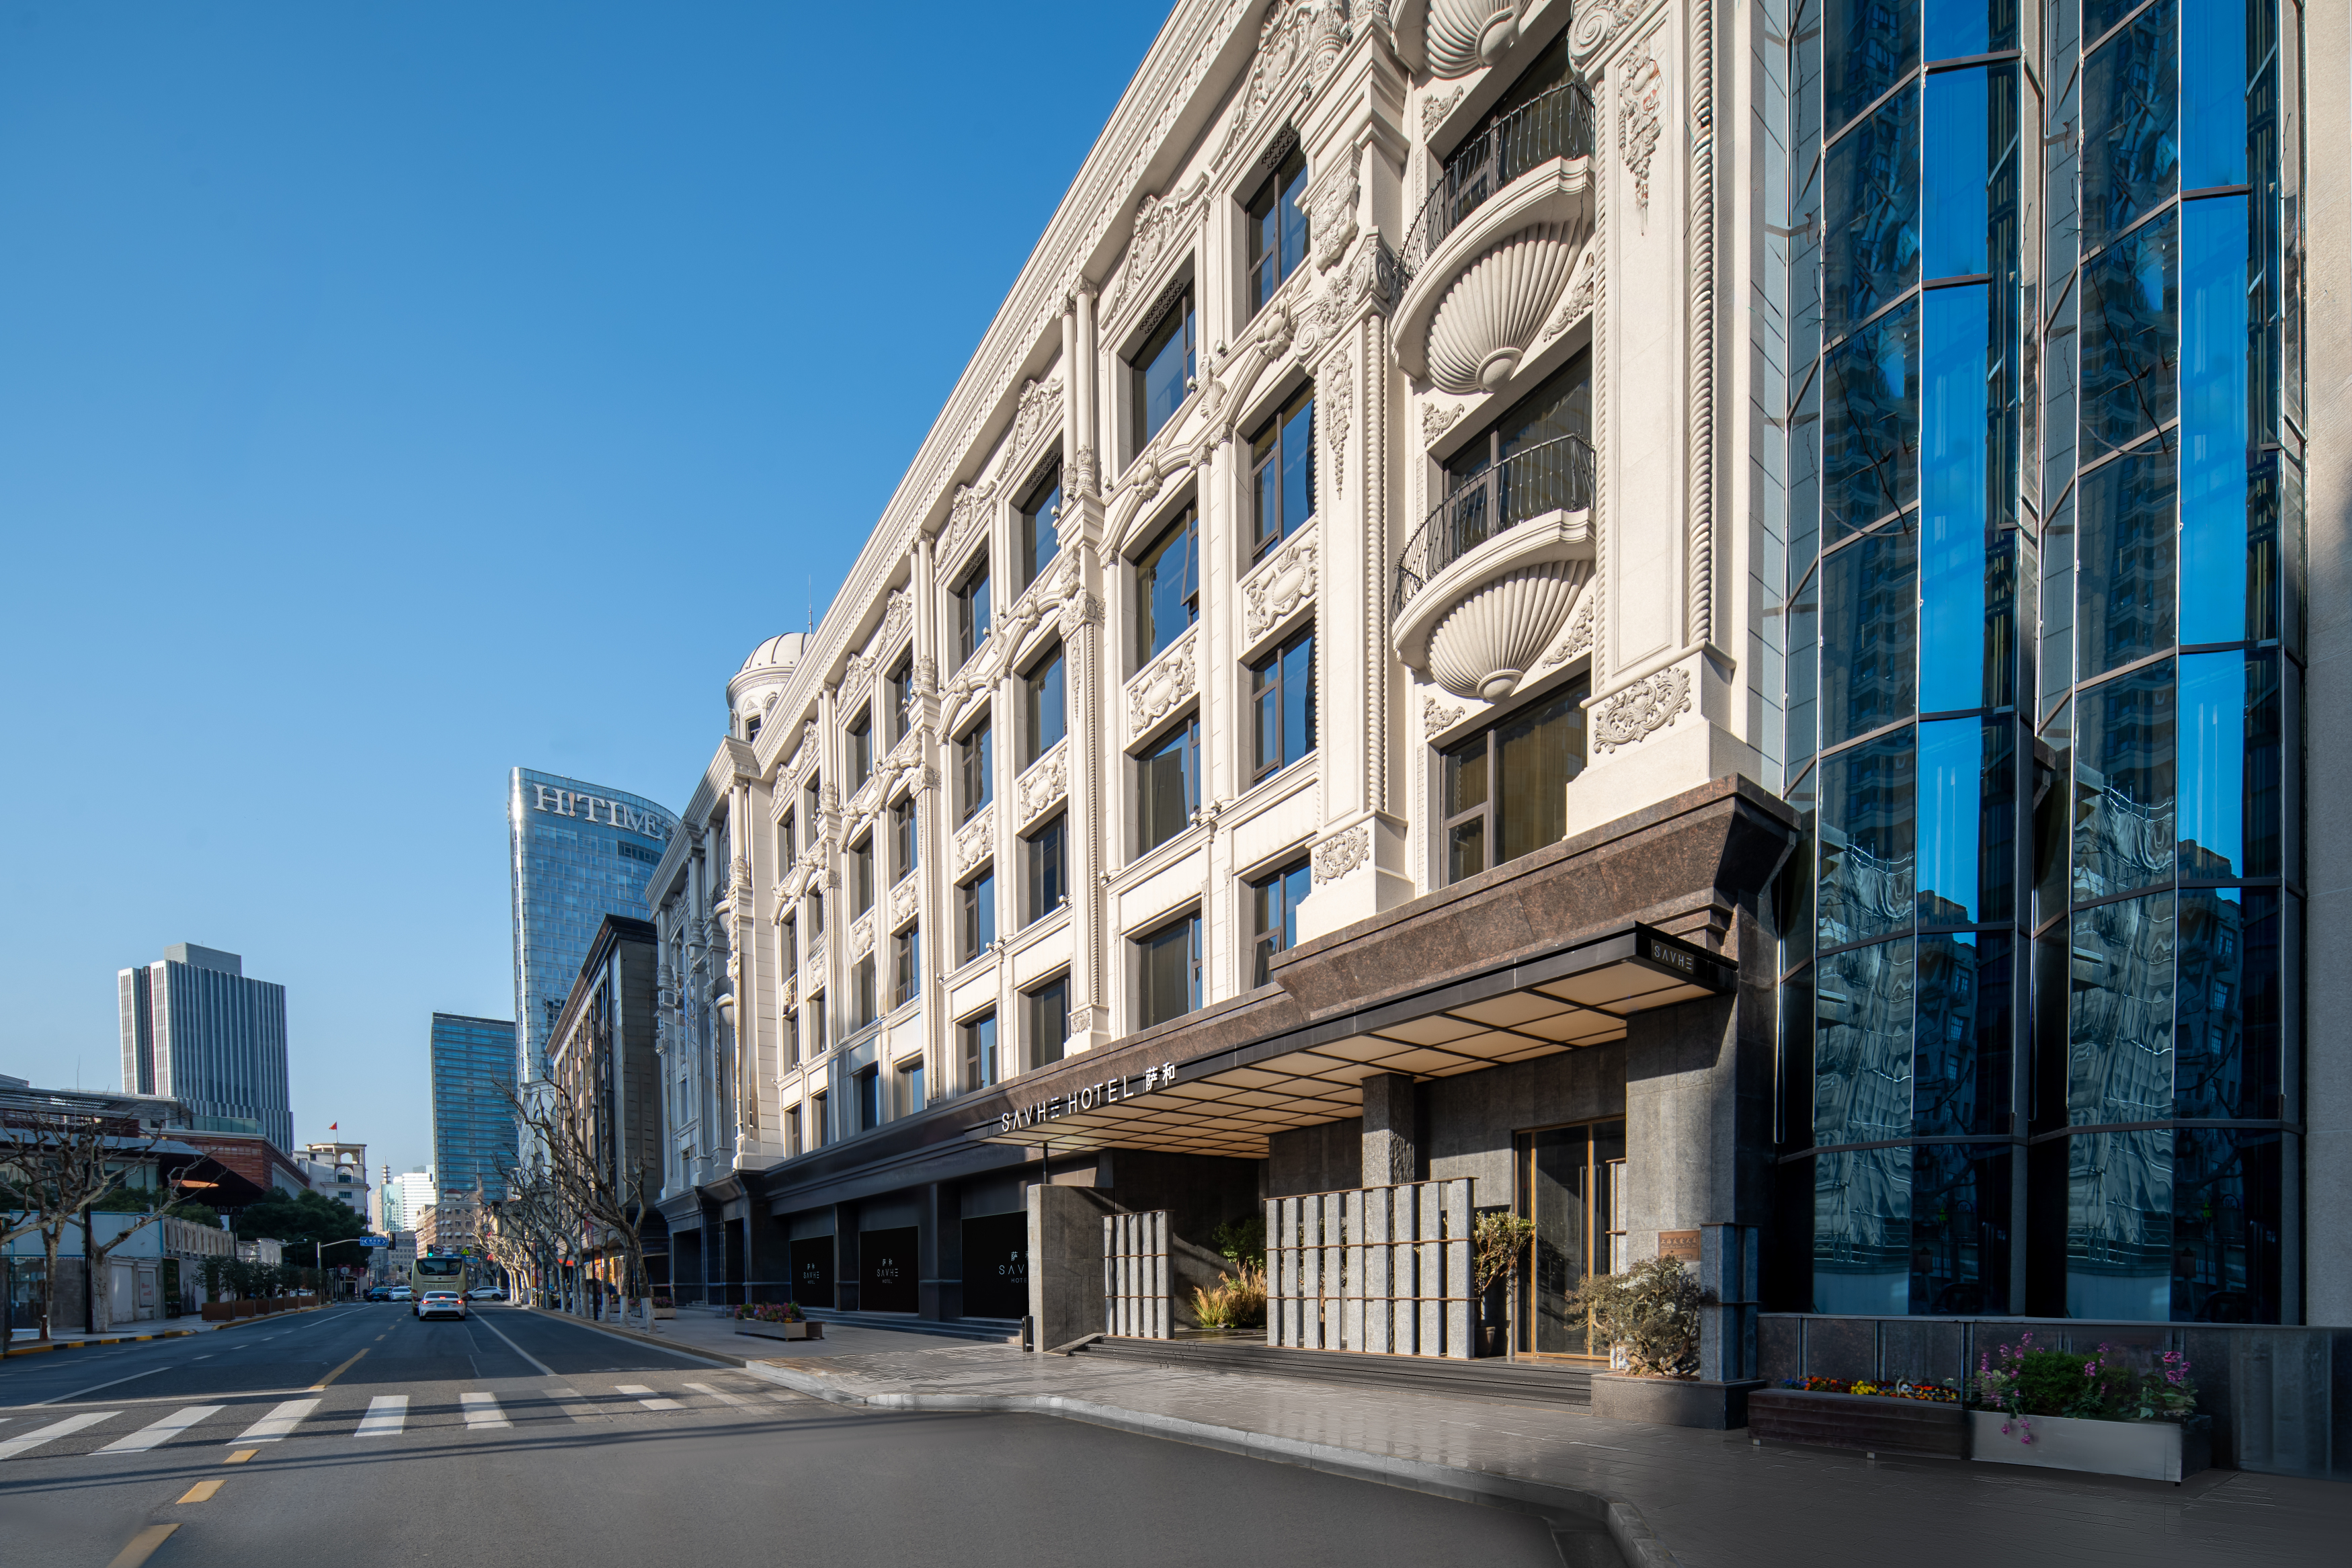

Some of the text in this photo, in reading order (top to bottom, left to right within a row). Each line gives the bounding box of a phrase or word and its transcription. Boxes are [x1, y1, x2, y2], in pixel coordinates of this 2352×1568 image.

[1654, 945, 1693, 970] SAVHE
[1002, 1061, 1176, 1132] SAVHE HOTEL 萨和
[999, 1264, 1024, 1275] SAV
